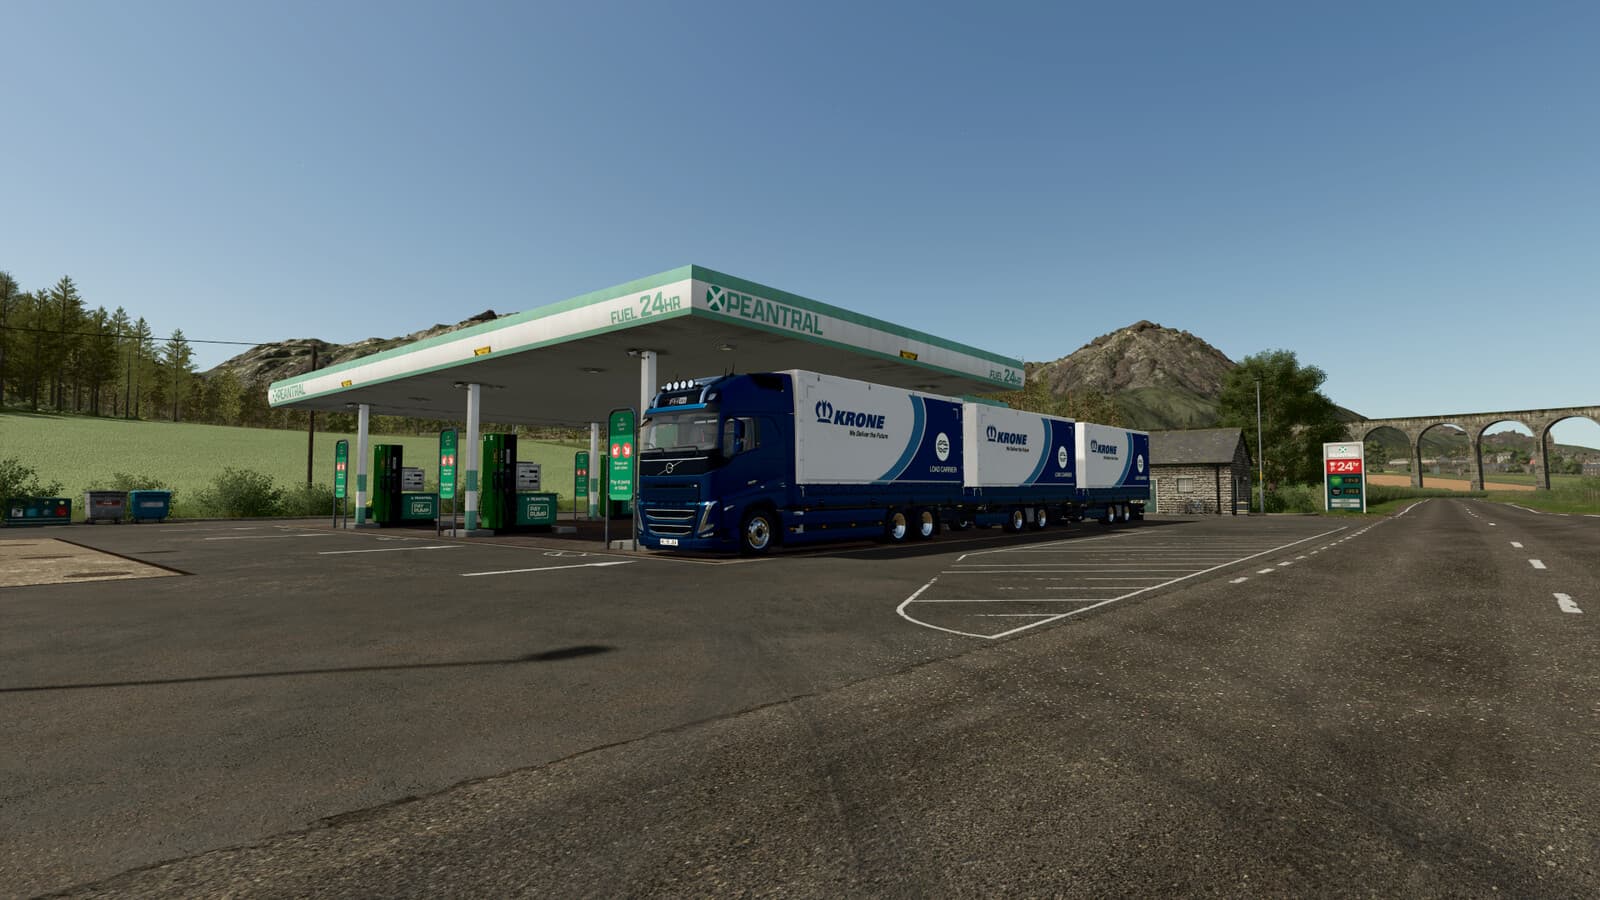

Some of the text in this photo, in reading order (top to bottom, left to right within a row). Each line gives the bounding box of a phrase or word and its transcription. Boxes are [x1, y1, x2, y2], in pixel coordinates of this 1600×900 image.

[610, 307, 637, 324] FUEL
[834, 410, 885, 429] KRONE
[997, 431, 1027, 445] KRONE
[1097, 444, 1118, 455] KRONE
[929, 465, 958, 474] LOAD CARRIER
